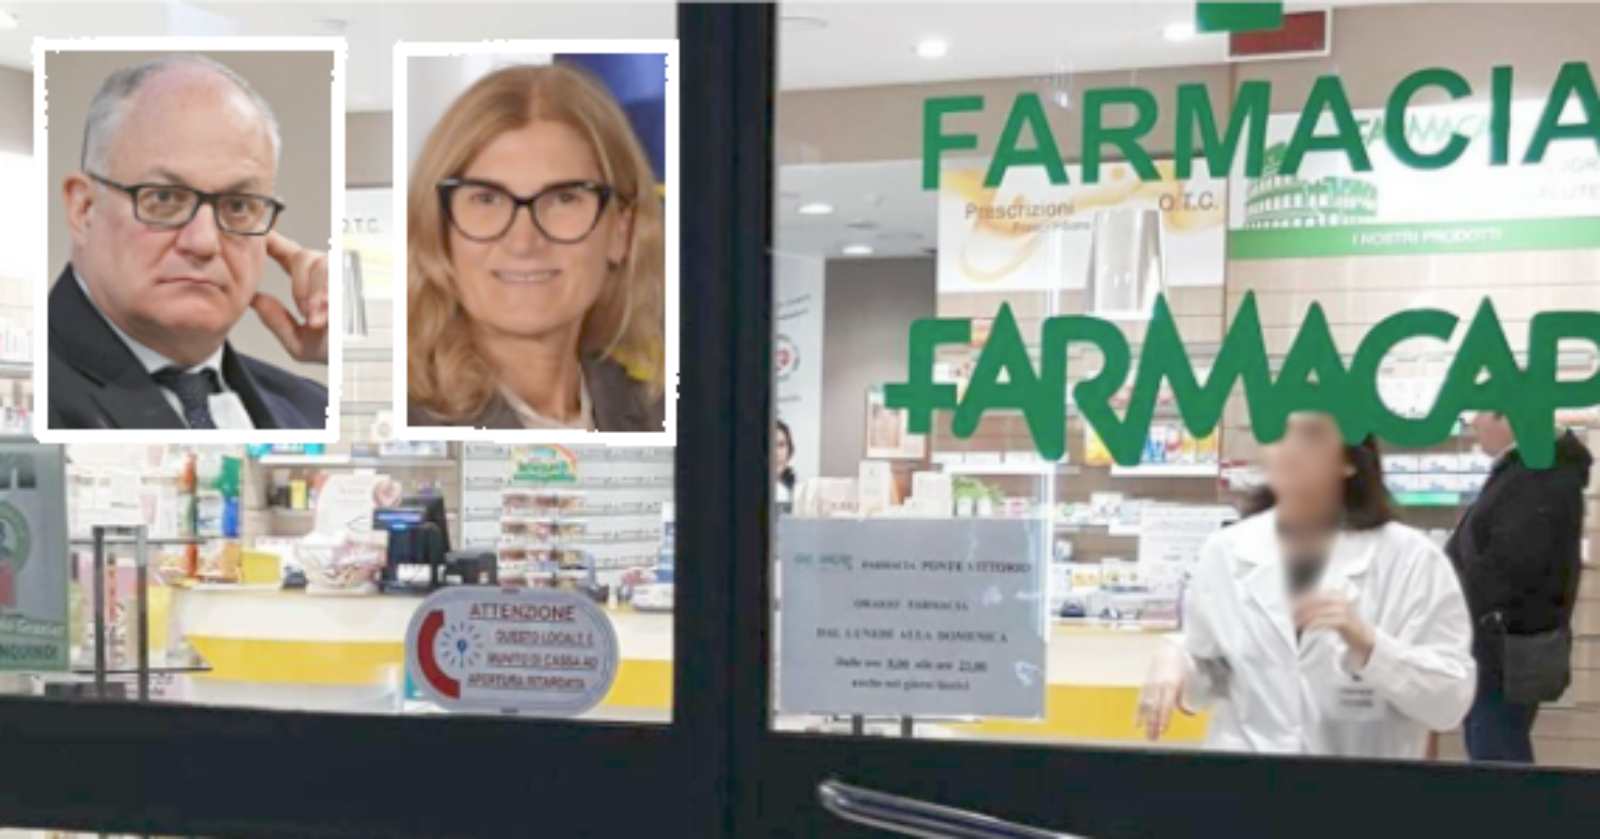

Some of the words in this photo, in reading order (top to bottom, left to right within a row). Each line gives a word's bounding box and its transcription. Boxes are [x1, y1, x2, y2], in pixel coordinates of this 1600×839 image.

[921, 60, 1600, 190] FARMACIA
[964, 199, 1075, 221] Prescrizioni
[469, 602, 577, 621] ATTENZIONE
